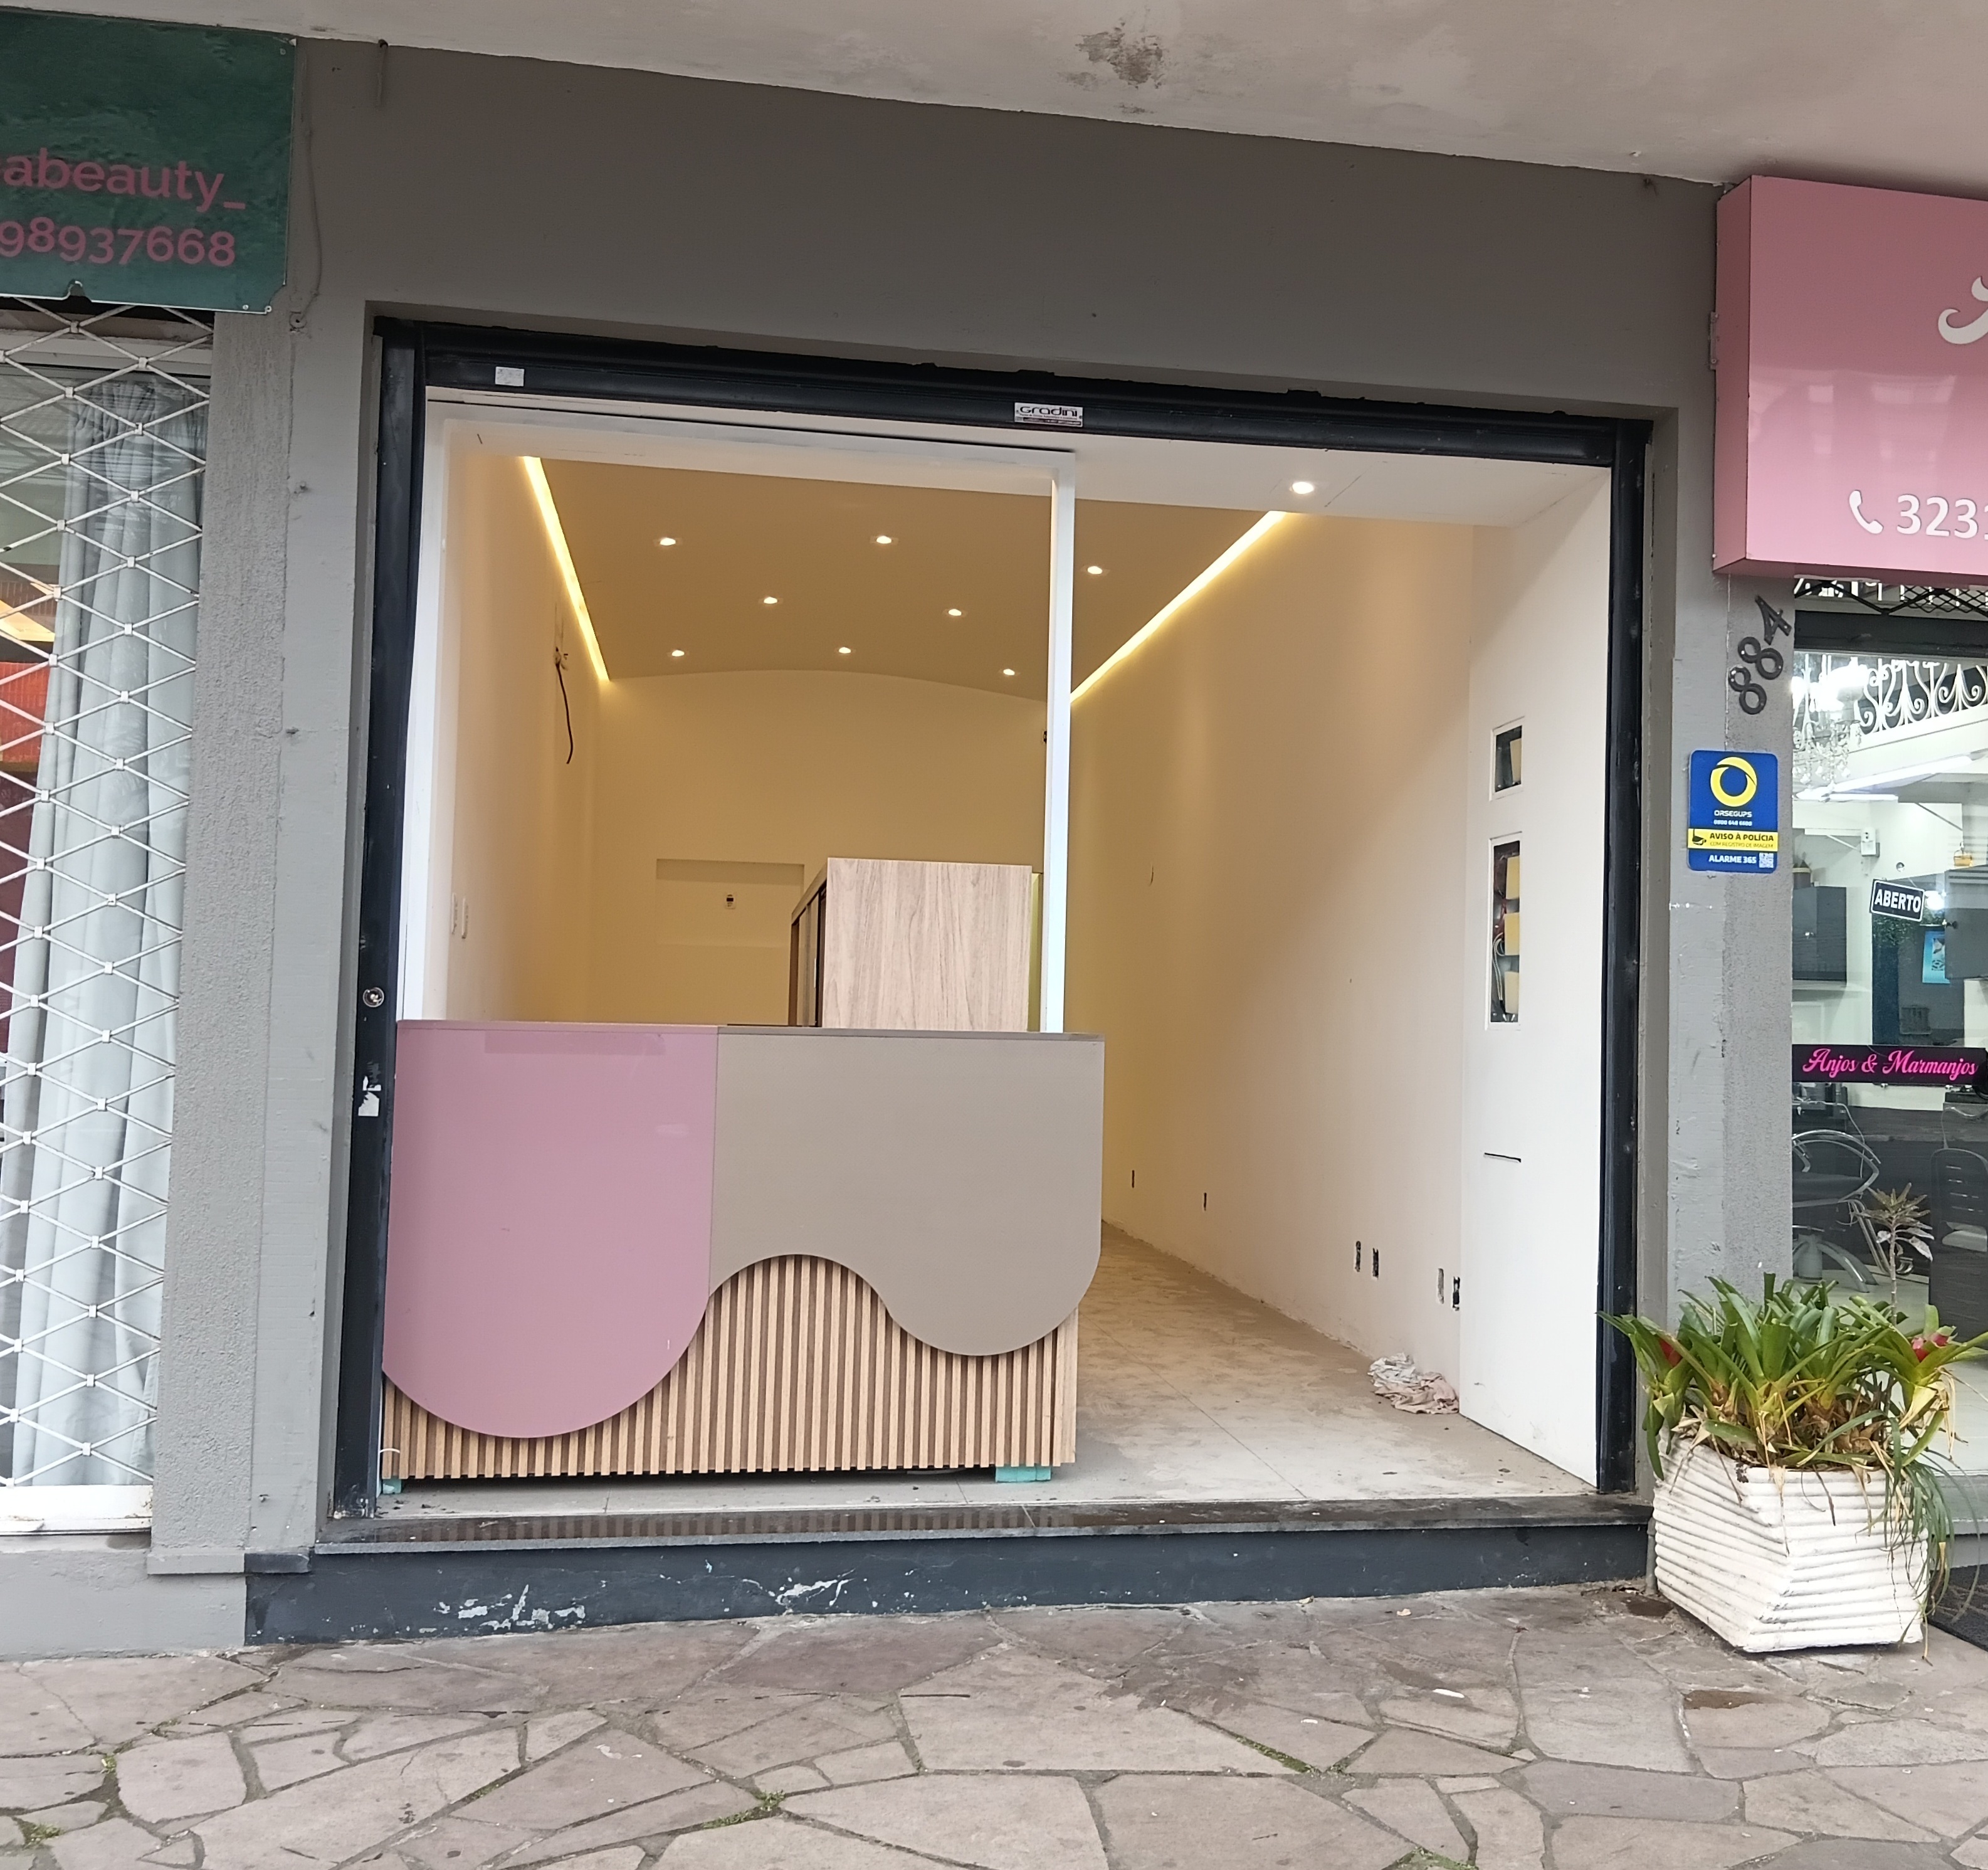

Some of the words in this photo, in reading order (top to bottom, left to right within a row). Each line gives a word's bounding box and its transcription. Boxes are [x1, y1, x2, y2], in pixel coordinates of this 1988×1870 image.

[0, 216, 236, 267] 98937668
[1896, 494, 1988, 541] 323
[1728, 595, 1792, 715] 884
[1713, 810, 1752, 818] ORSEGUPS
[1735, 832, 1741, 840] À
[1743, 833, 1774, 842] POLÍCIA
[1708, 855, 1742, 864] ALARME
[1743, 856, 1757, 864] 365
[1874, 889, 1922, 913] ABERTO
[1802, 1048, 1857, 1079] Anjos
[1861, 1054, 1878, 1074] &
[1882, 1050, 1978, 1081] Marmanjos
